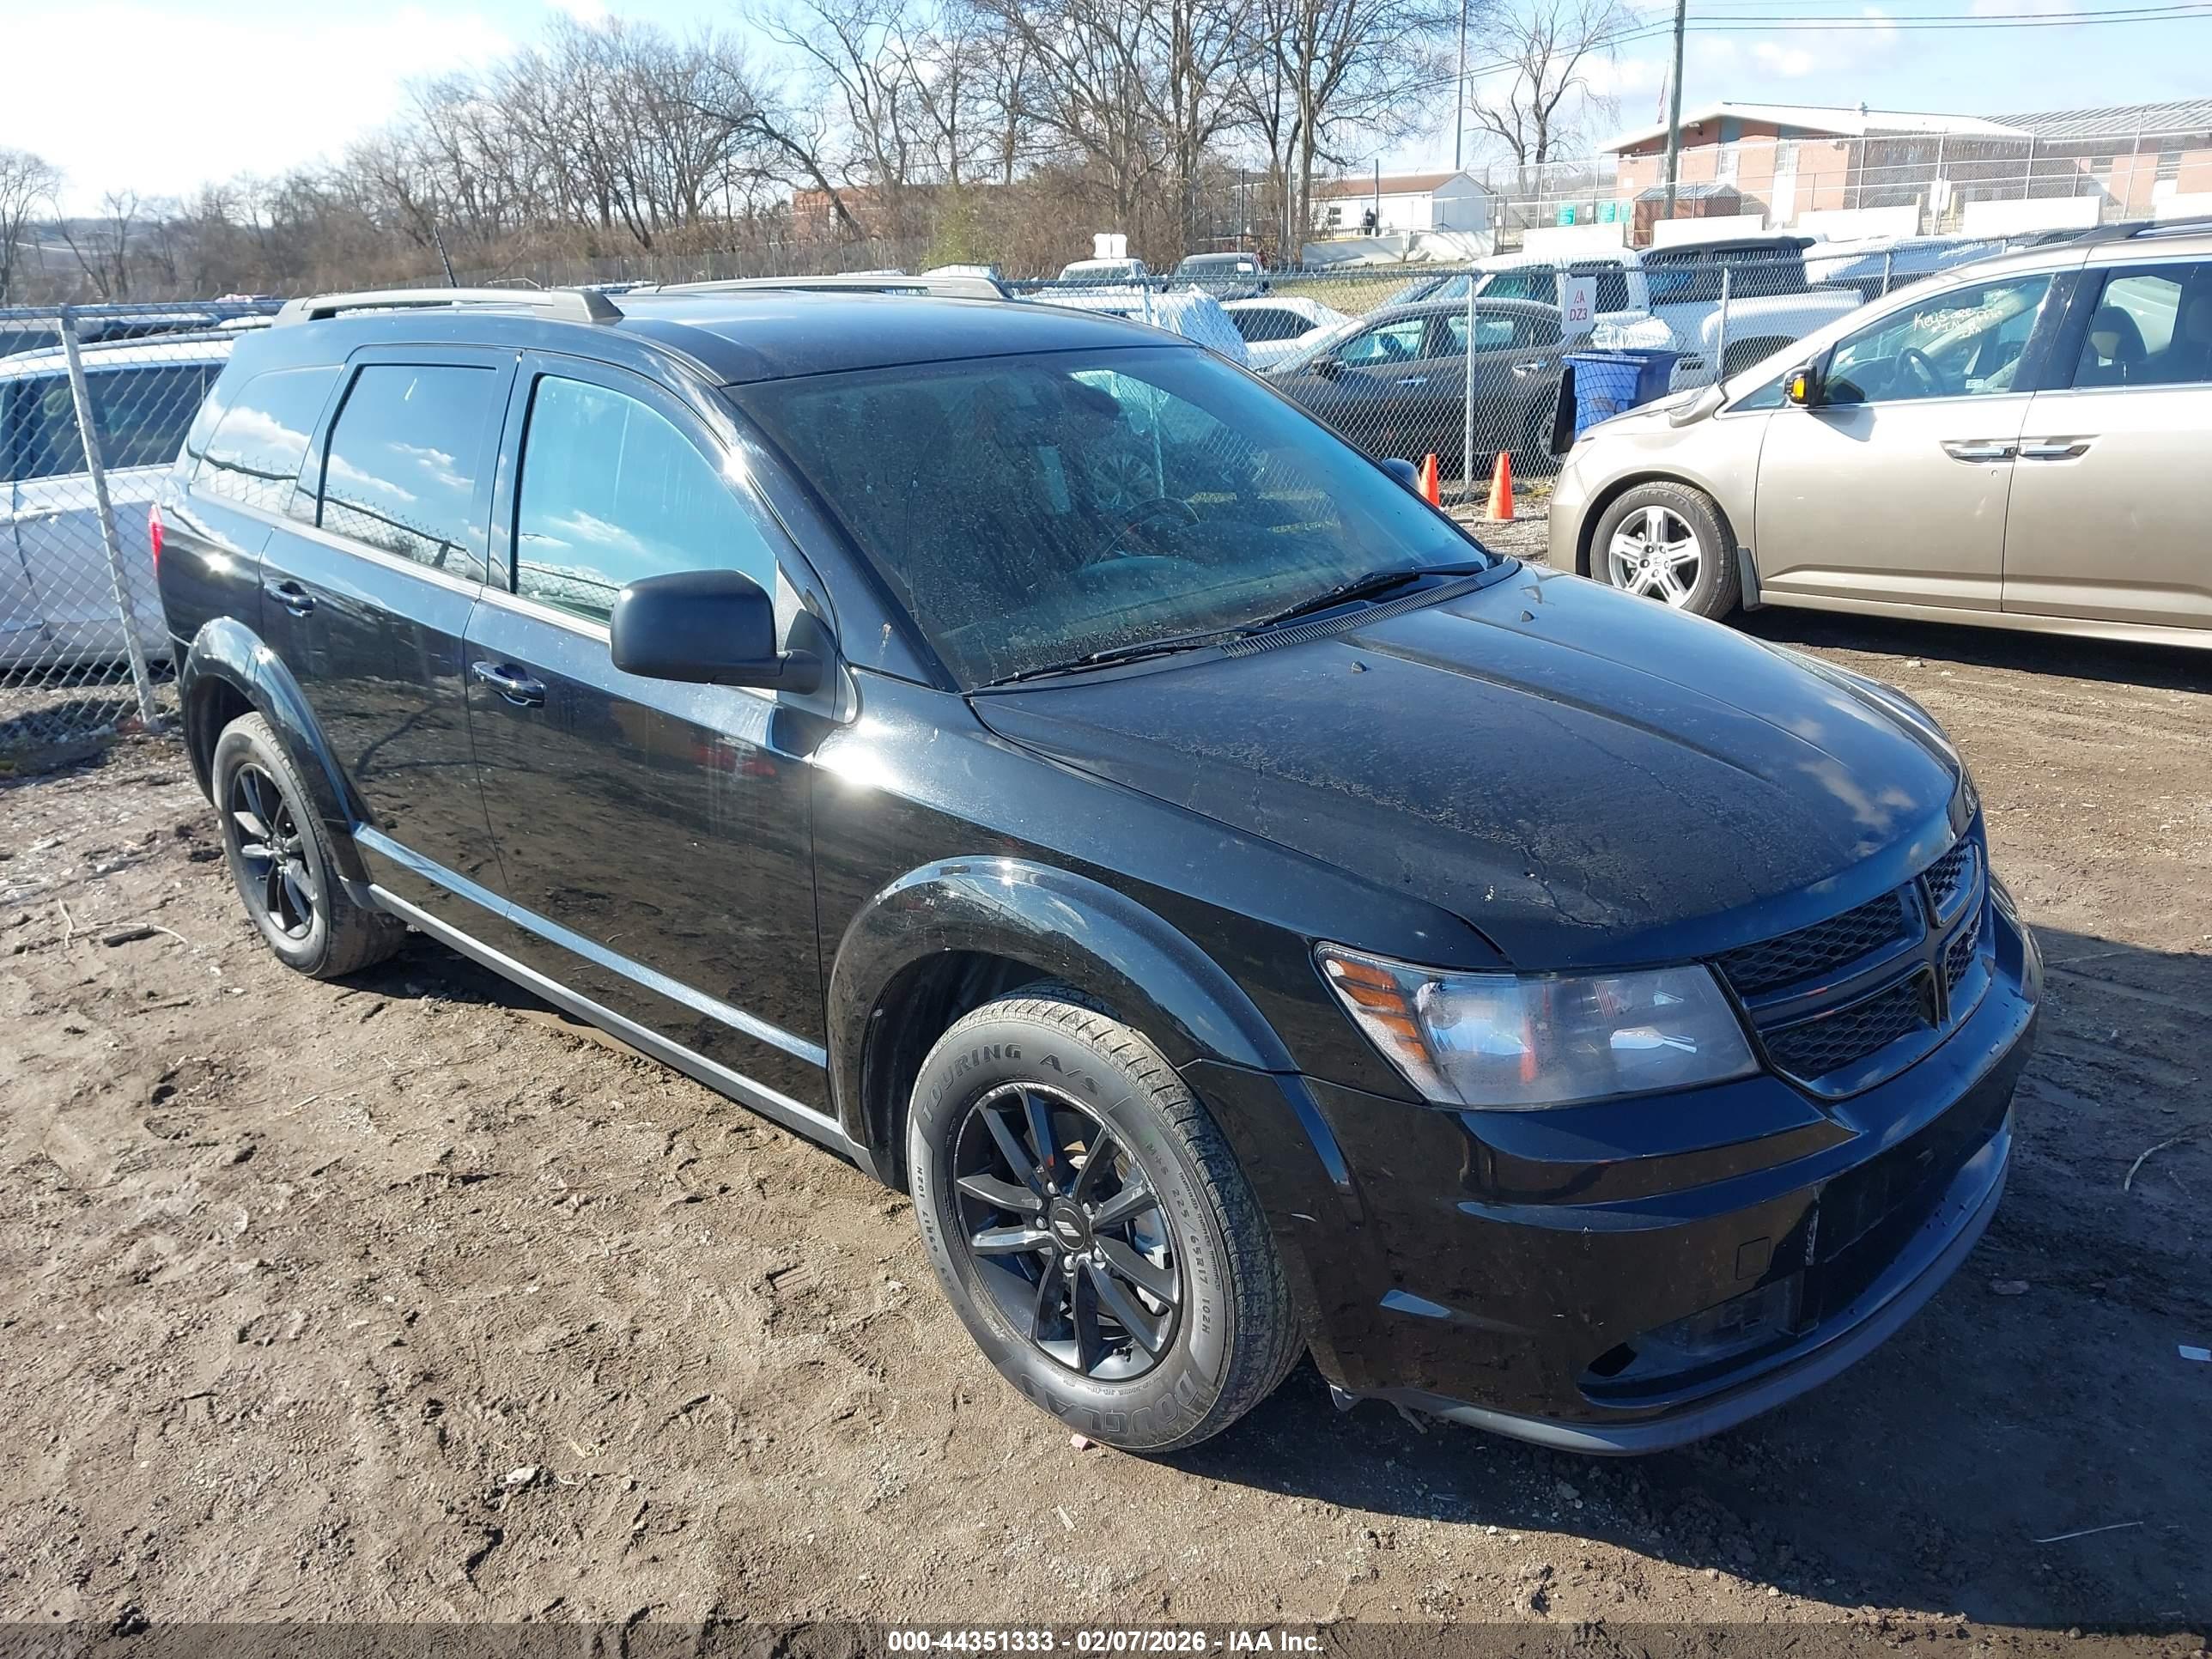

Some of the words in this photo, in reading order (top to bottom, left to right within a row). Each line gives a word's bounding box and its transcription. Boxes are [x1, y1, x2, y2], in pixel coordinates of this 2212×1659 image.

[1569, 307, 1589, 322] DZ3
[1913, 310, 1947, 333] Keys
[921, 1042, 1023, 1125] TOURING
[1037, 1052, 1103, 1097] A/S
[915, 1165, 927, 1199] 102H
[1170, 1187, 1210, 1287] 225/65R17
[1200, 1297, 1212, 1336] 102H
